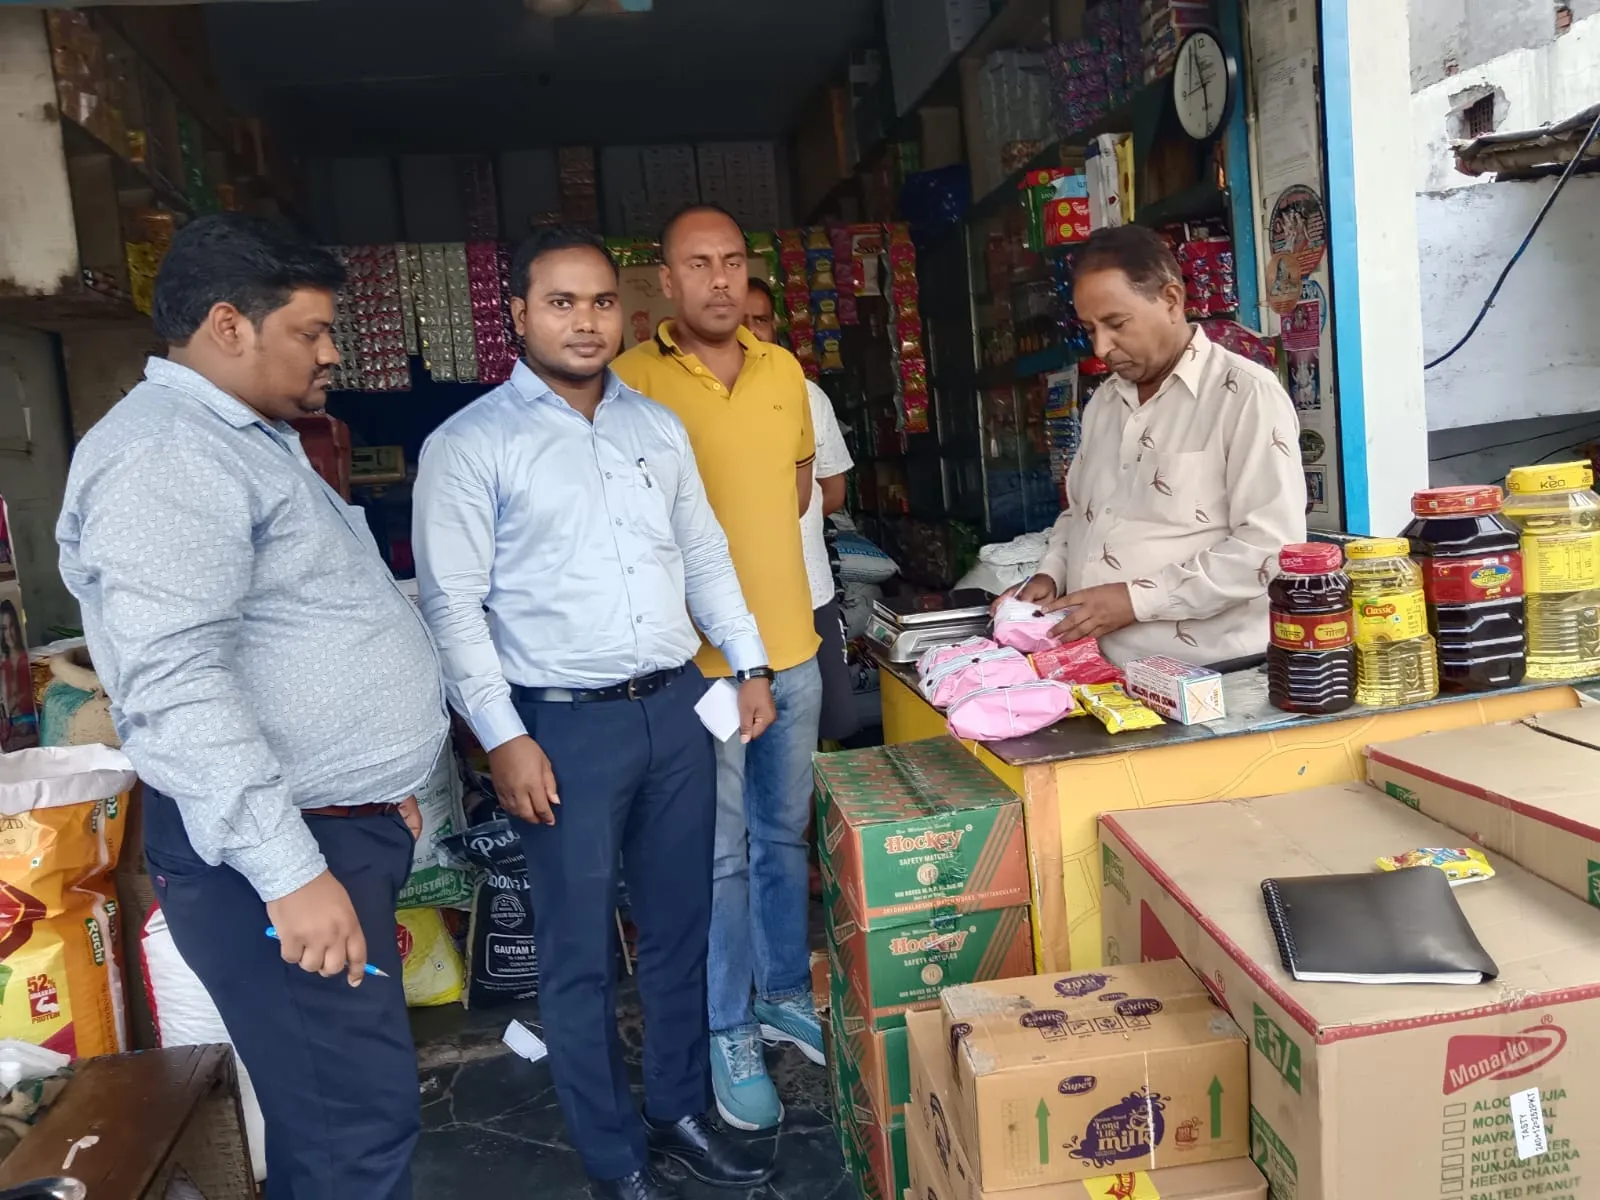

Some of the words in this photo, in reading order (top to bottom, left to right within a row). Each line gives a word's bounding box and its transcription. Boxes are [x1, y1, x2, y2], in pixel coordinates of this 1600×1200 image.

[1365, 603, 1393, 616] Classic
[884, 829, 965, 854] Hockey
[899, 857, 922, 866] SAFETY
[924, 852, 954, 863] MATCHES
[399, 871, 456, 900] NDUSTRIES
[87, 919, 104, 963] Ruchi
[493, 944, 529, 955] GAUTAM
[889, 930, 968, 956] Hockey
[32, 1011, 60, 1024] PROTEIN
[1449, 1040, 1529, 1089] Monarko
[1061, 1080, 1093, 1092] Super
[1093, 1120, 1120, 1131] Long
[1472, 1113, 1514, 1129] MOON
[1519, 1114, 1530, 1140] TASTY
[1098, 1126, 1153, 1153] milk
[1471, 1156, 1530, 1176] PUNJABI
[1537, 1148, 1580, 1165] TADKA
[1472, 1149, 1497, 1163] NUT
[1470, 1170, 1518, 1189] HEENG
[1522, 1162, 1570, 1180] CHANA
[1470, 1187, 1523, 1200] SALTED
[1526, 1175, 1582, 1196] PEANUT
